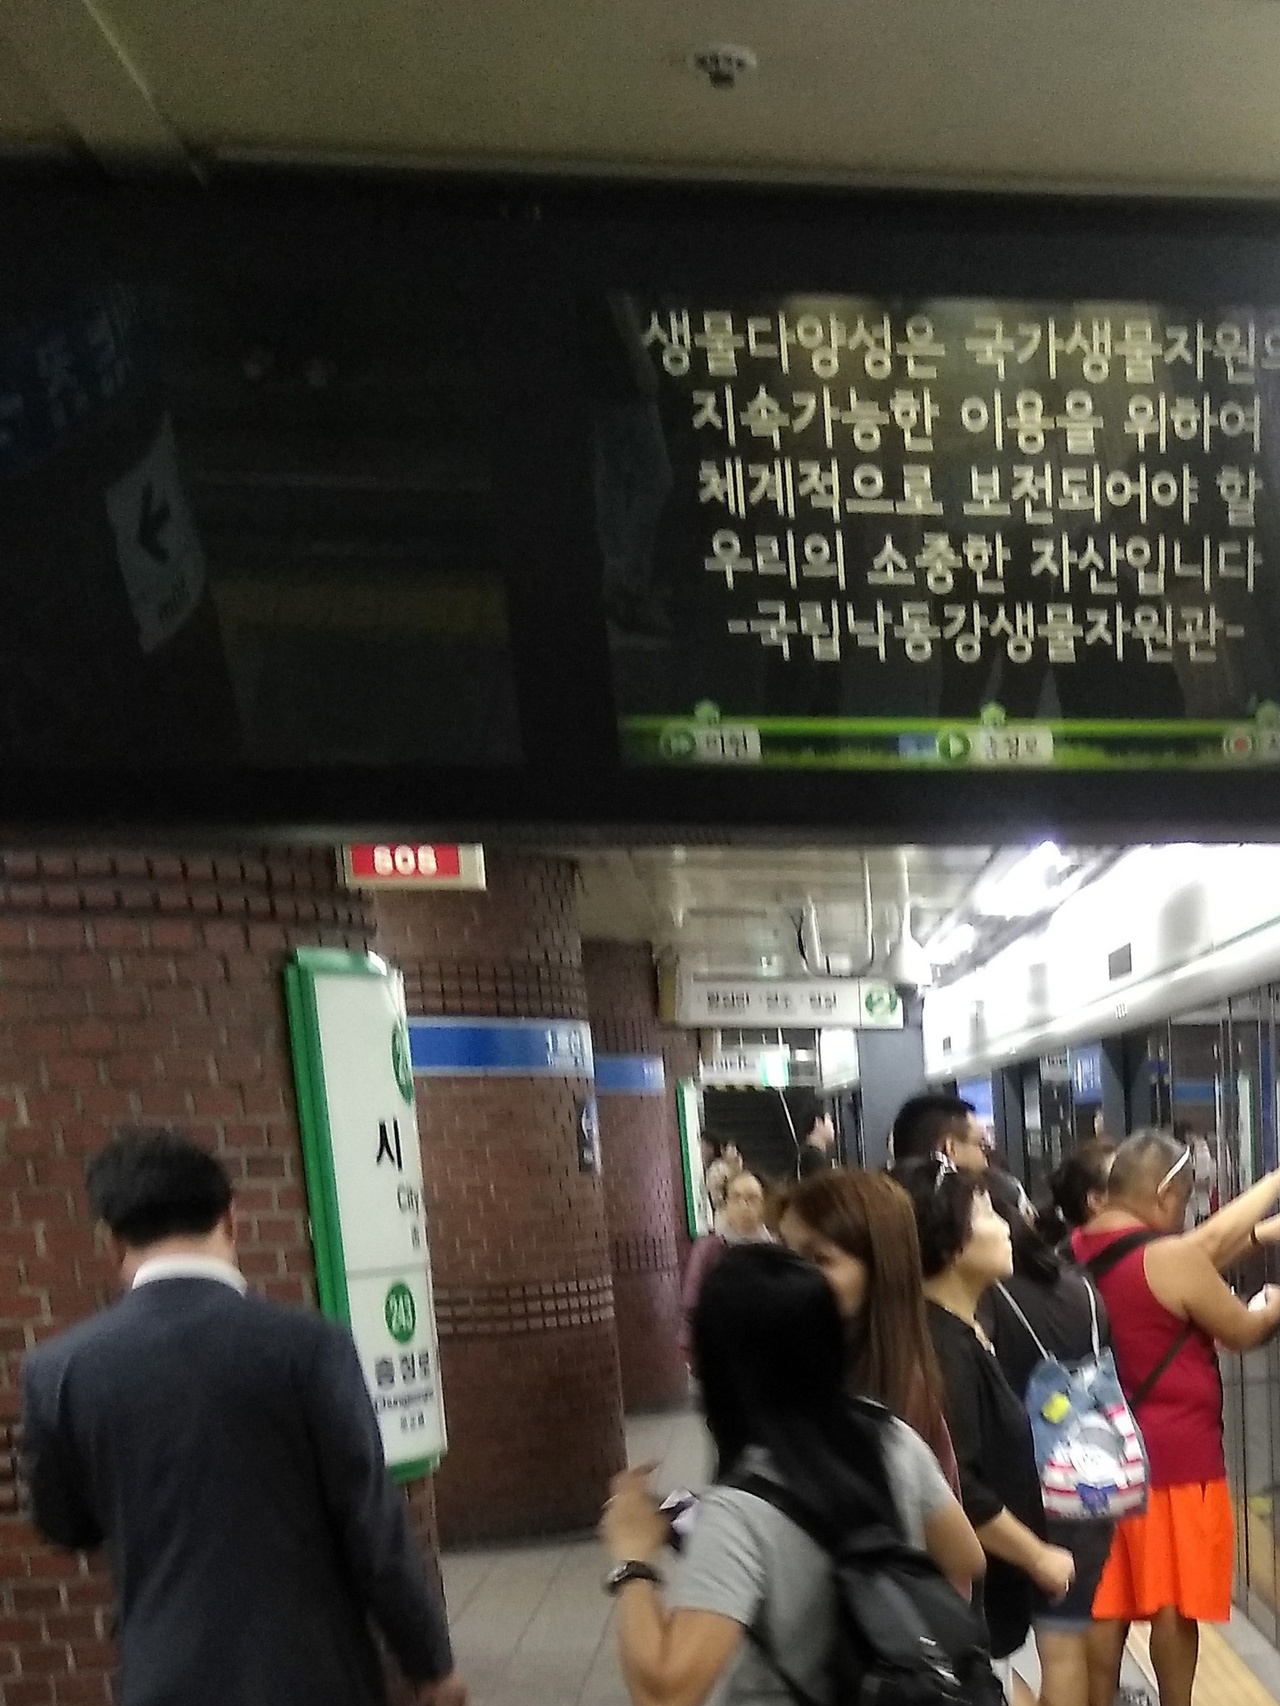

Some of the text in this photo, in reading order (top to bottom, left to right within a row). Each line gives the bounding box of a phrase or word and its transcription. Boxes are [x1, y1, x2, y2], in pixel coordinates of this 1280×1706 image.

[642, 310, 946, 379] 생물다양성은
[692, 384, 1261, 455] 지속가능한 이용을 위하여
[699, 456, 1264, 528] 체계적으로 보전되어야 할
[705, 527, 1264, 595] 우리의 소중한 자산입니다
[376, 1117, 403, 1173] 시
